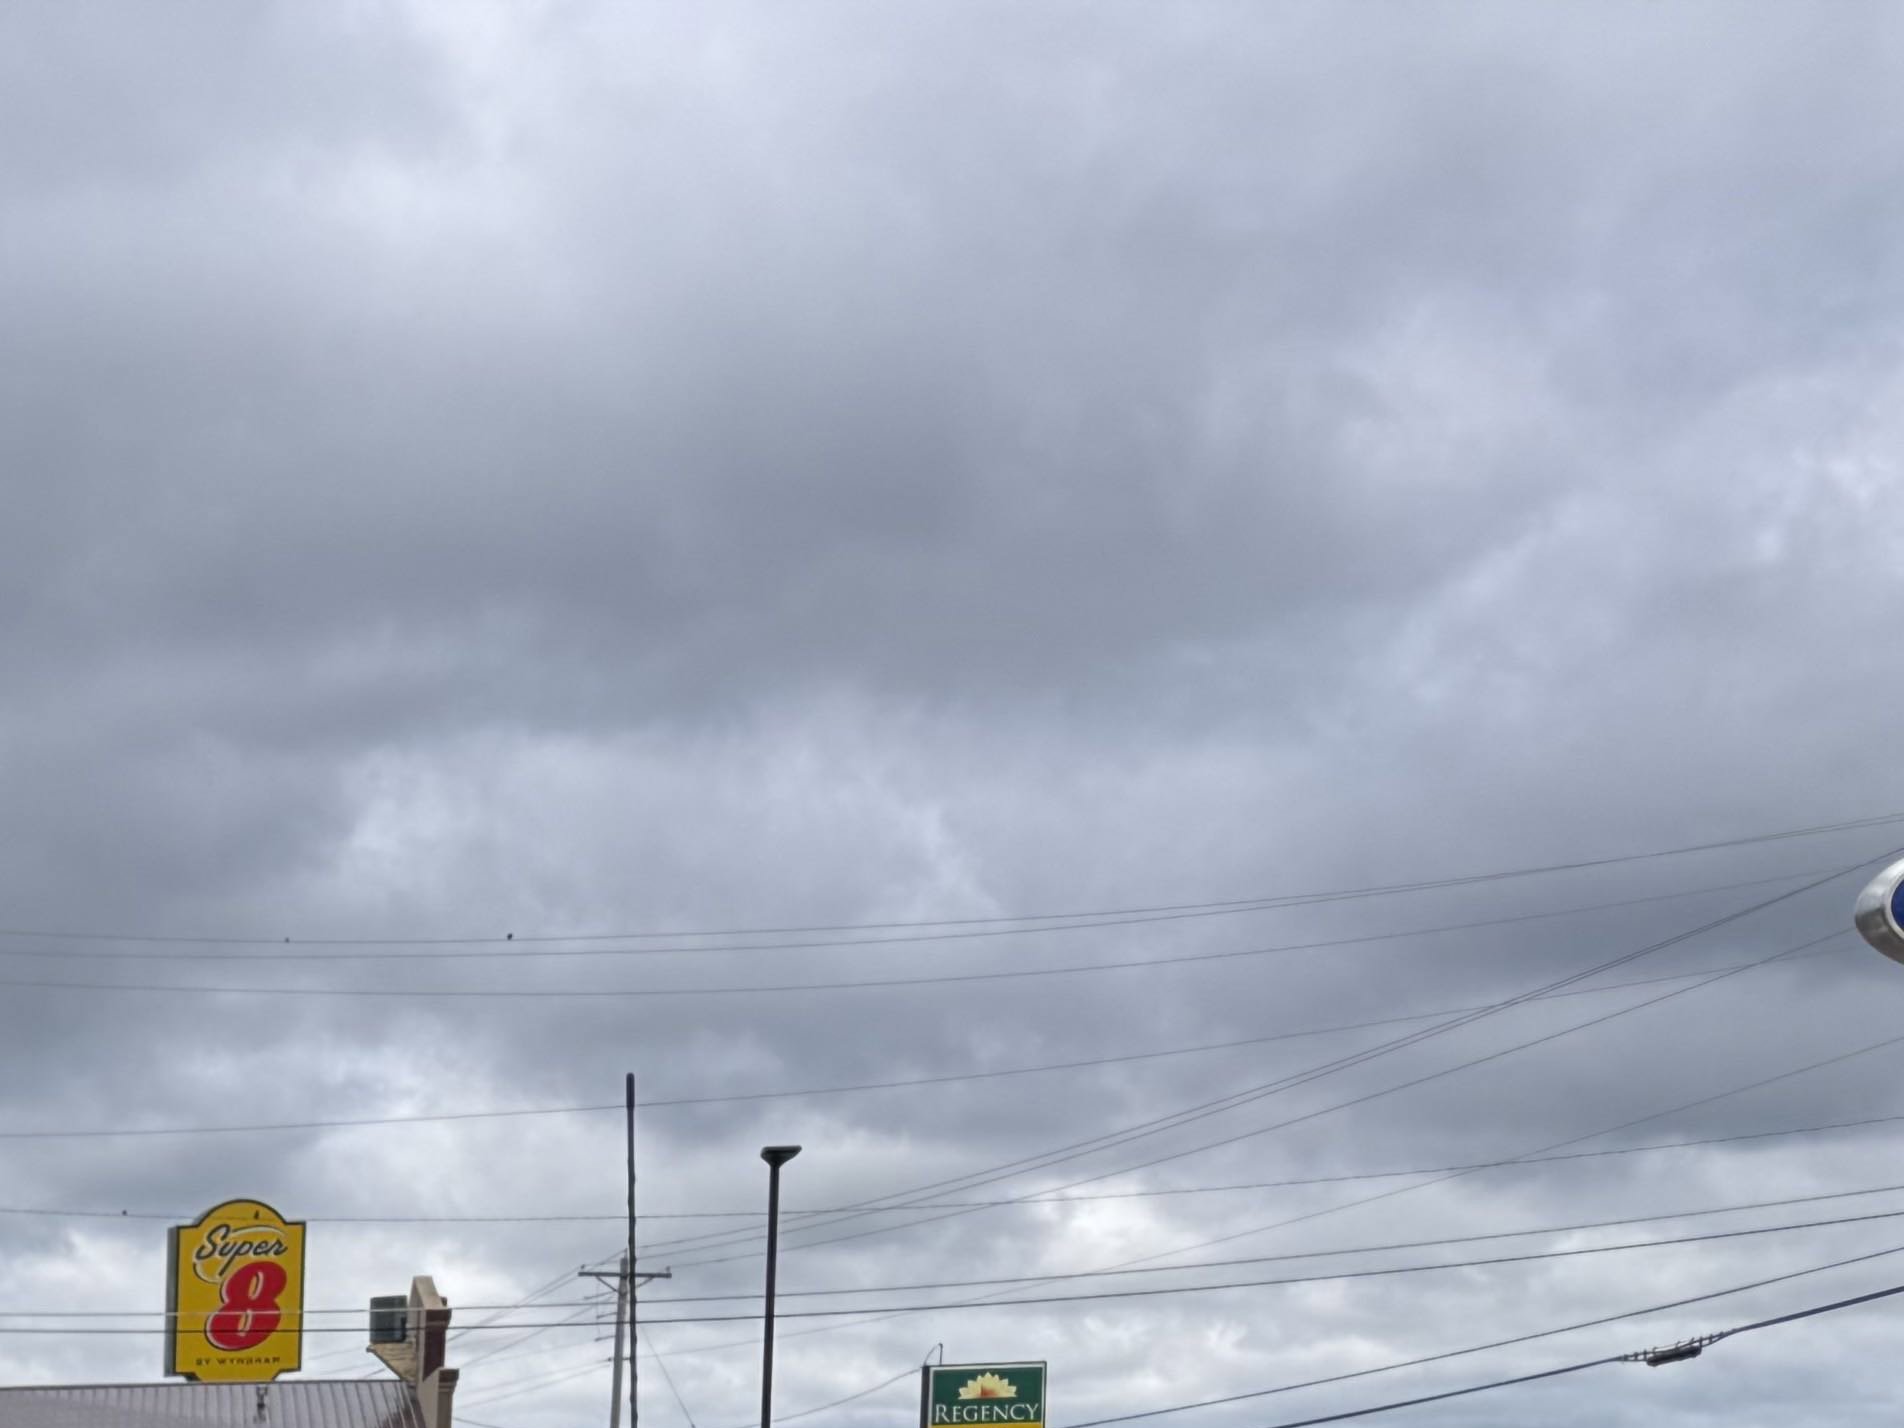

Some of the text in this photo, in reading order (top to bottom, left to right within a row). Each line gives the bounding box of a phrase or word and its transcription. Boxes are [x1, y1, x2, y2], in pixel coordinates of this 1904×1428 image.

[195, 1223, 288, 1276] Super
[204, 1261, 288, 1352] 8
[935, 1403, 1039, 1424] REGENCY
